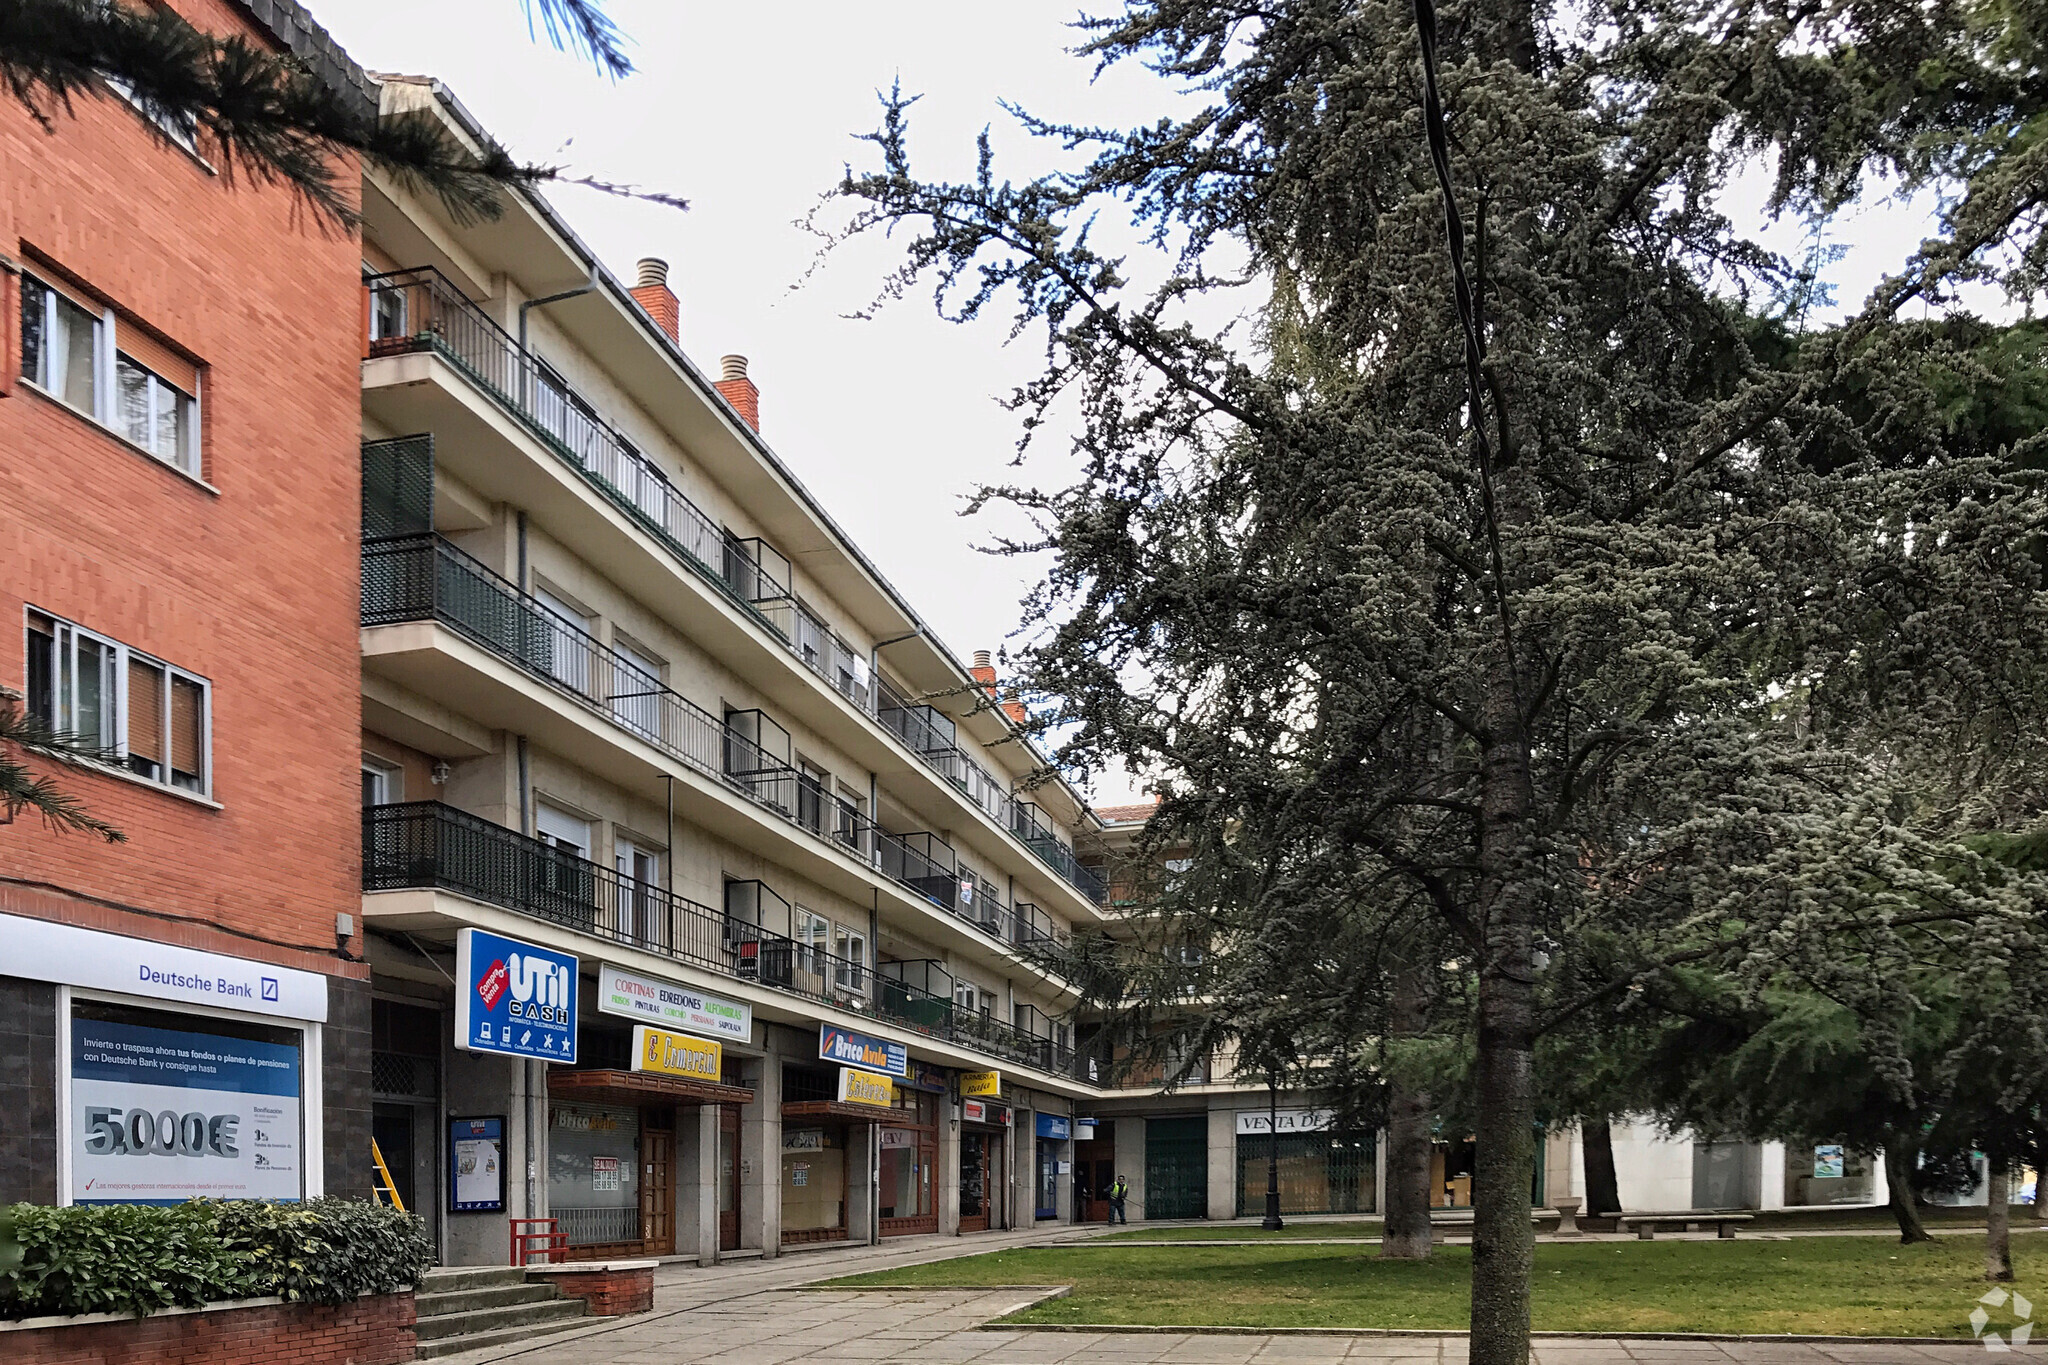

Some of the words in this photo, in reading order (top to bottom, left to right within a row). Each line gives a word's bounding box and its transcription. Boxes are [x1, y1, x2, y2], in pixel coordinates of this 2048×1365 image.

[140, 965, 212, 991] Deutsche
[217, 978, 252, 998] Bank
[479, 968, 502, 996] Compra
[483, 983, 500, 1004] Venta
[509, 999, 569, 1026] CASH
[611, 994, 630, 1006] FRISOS
[634, 1000, 660, 1013] PINTURAS
[664, 1007, 686, 1019] CORCHO
[690, 1013, 715, 1026] PERSIANAS
[615, 979, 655, 999] CORTINAS
[659, 989, 701, 1010] EDREDONES
[704, 1001, 742, 1020] ALFOMBRAS
[83, 1037, 114, 1050] Invierte
[115, 1042, 121, 1050] o
[122, 1043, 154, 1054] traspasa
[155, 1046, 176, 1056] ahora
[177, 1048, 190, 1057] tus
[190, 1049, 216, 1061] fondos
[217, 1054, 223, 1062] o
[223, 1054, 246, 1064] planes
[247, 1056, 257, 1065] de
[257, 1059, 290, 1069] pensiones
[83, 1053, 99, 1062] con
[101, 1053, 137, 1065] Deutsche
[139, 1057, 158, 1068] Bank
[159, 1060, 165, 1070] y
[165, 1061, 197, 1072] consigue
[198, 1063, 217, 1074] hasta
[663, 1035, 718, 1075] Comercial
[847, 1072, 886, 1102] Estévez
[967, 1082, 990, 1094] Rafa
[84, 1105, 240, 1158] 5.000€
[1243, 1116, 1295, 1129] VENTA
[1301, 1114, 1322, 1128] DE
[95, 1182, 107, 1190] Las
[131, 1183, 156, 1191] gestoras
